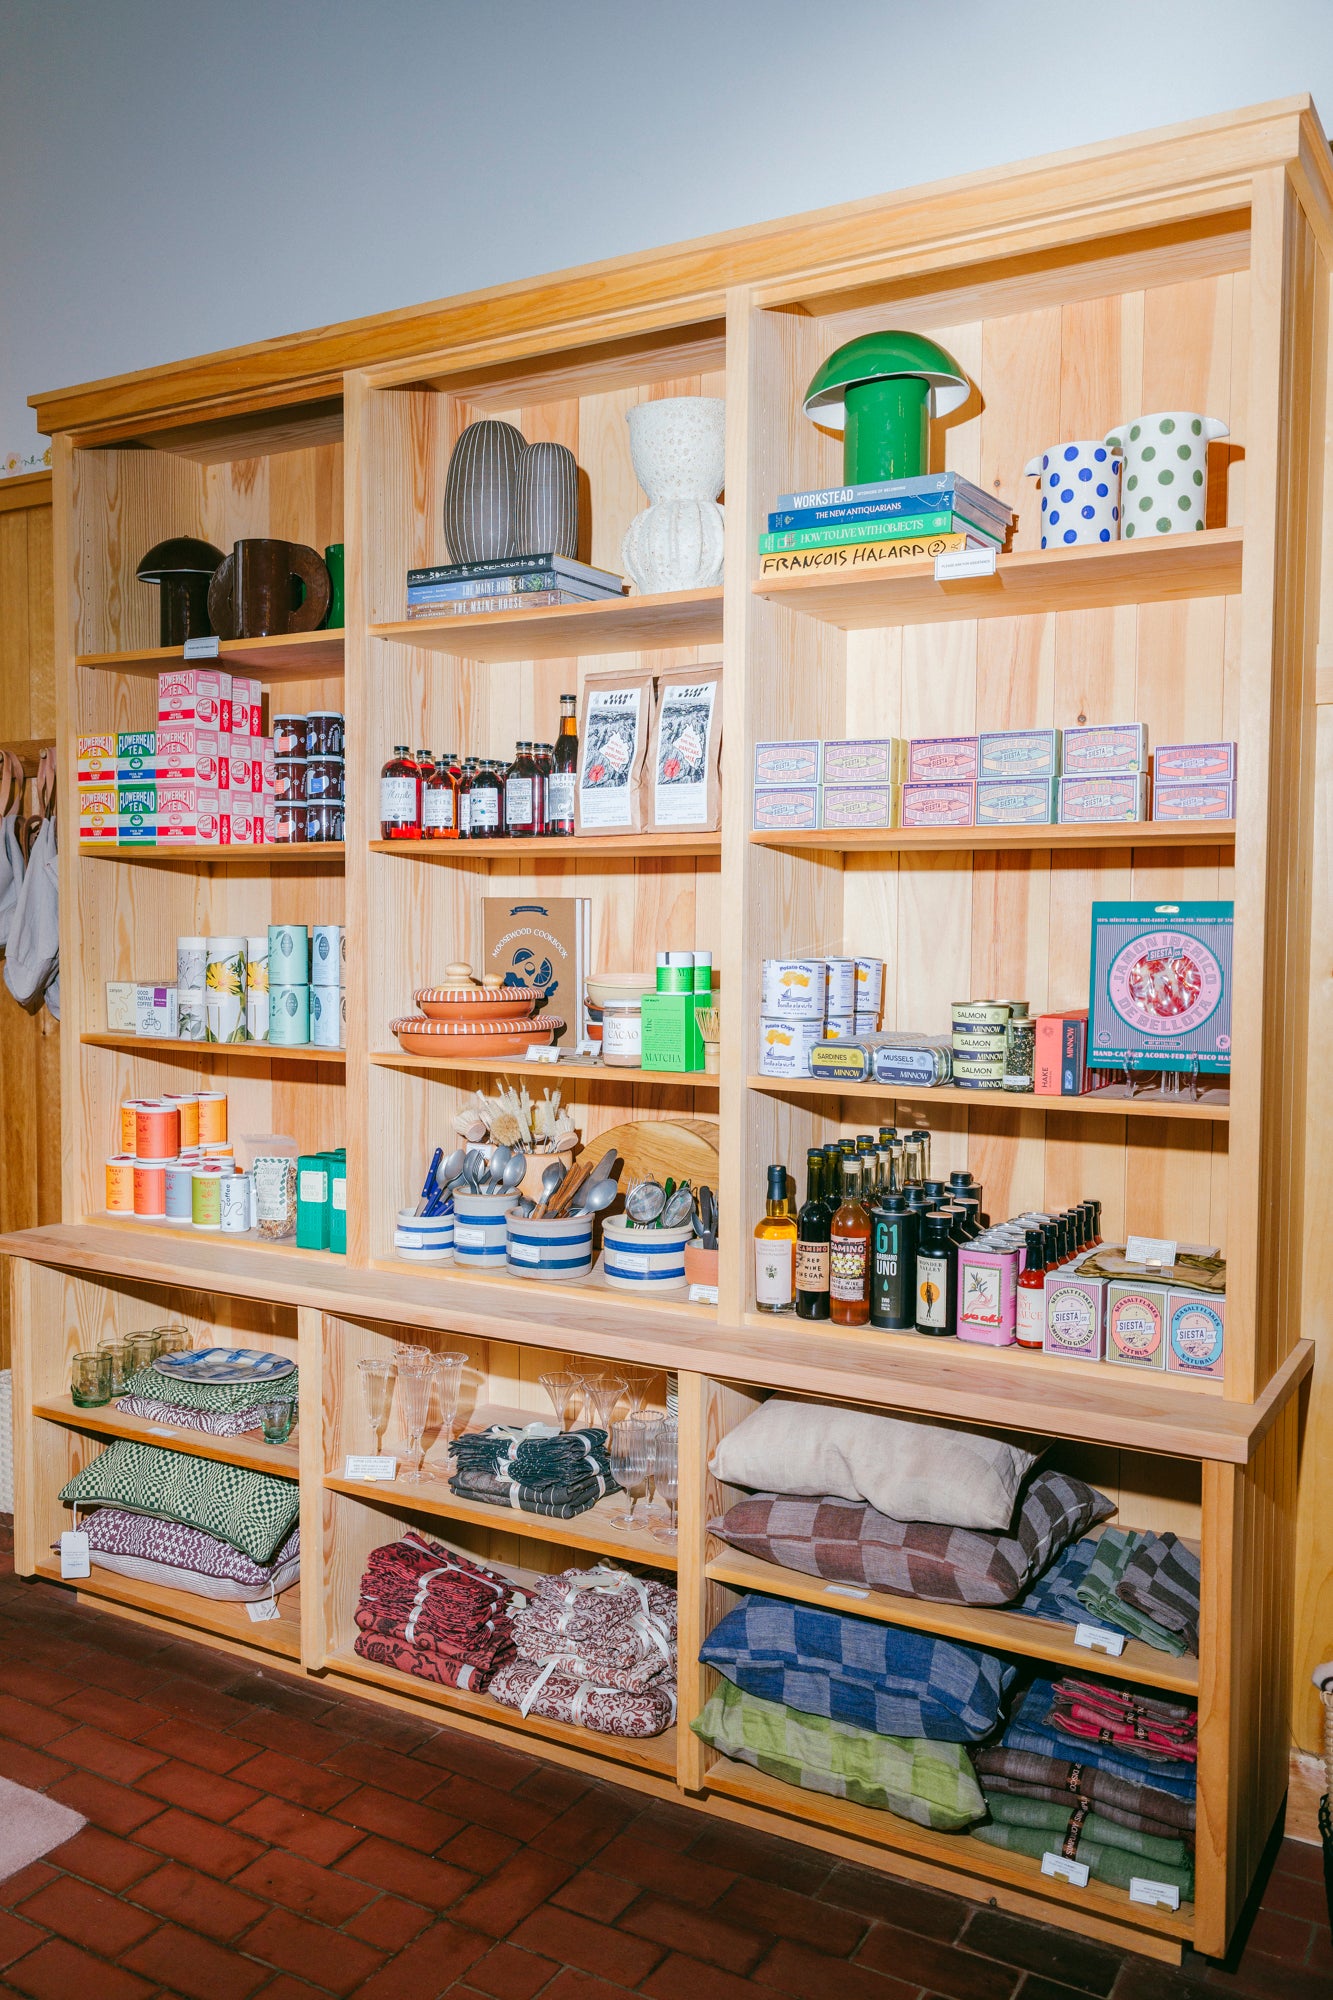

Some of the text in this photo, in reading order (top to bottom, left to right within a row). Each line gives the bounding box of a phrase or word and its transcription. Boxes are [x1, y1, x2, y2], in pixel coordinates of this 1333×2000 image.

[793, 489, 854, 509] WORKSTEAD
[815, 502, 902, 520] THE NEW ANTIQUARIANS
[800, 520, 924, 544] HOW TO LIVE WITH OBJECTS
[763, 549, 848, 574] FRANÇOIS
[852, 544, 925, 565] HALARD
[462, 583, 474, 596] THE
[475, 582, 495, 595] MAINE
[496, 579, 518, 594] HOUSE
[453, 602, 467, 614] THE
[470, 600, 494, 612] MAINE
[498, 596, 523, 609] HOUSE
[159, 672, 194, 697] FLOWERHEAD
[78, 735, 113, 758] FLOWERHEAD
[118, 732, 155, 756] FLOWERHEAD
[156, 731, 193, 755] FLOWERHEAD
[128, 746, 143, 755] TEA
[167, 744, 181, 753] TEA
[1087, 748, 1105, 758] SIESTA
[1003, 751, 1021, 760] SIESTA
[775, 762, 790, 771] SIESTA
[844, 758, 860, 767] SIESTA
[931, 758, 948, 767] SIESTA
[1183, 760, 1199, 768] SIESTA
[80, 791, 116, 814] FLOWERHEAD
[119, 790, 155, 812] FLOWERHEAD
[157, 789, 194, 812] FLOWERHEAD
[999, 798, 1016, 807] SIESTA
[1085, 798, 1103, 807] SIESTA
[89, 804, 104, 813] TEA
[128, 802, 143, 811] TEA
[168, 803, 182, 811] TEA
[924, 803, 941, 812] SIESTA
[492, 927, 568, 959] MOOSEWOOD COOKBOOK
[1149, 948, 1173, 960] SIESTA
[1114, 935, 1217, 986] JAMON IBERICO
[798, 965, 813, 973] Chips
[957, 1011, 987, 1019] SALMON
[1117, 997, 1213, 1032] DE BELLOTA
[607, 1019, 622, 1030] the
[780, 1024, 795, 1032] Chips
[827, 1020, 842, 1028] Chips
[972, 1025, 1000, 1033] MINNOW
[607, 1030, 639, 1040] CACAO
[960, 1039, 991, 1047] SALMON
[1066, 1027, 1074, 1058] MINNOW
[644, 1052, 682, 1063] MATCHA
[817, 1053, 847, 1061] SARDINES
[883, 1054, 914, 1063] MUSSELS
[1144, 1052, 1185, 1060] ACORN-FED
[833, 1068, 860, 1077] MINNOW
[900, 1070, 929, 1080] MINNOW
[961, 1066, 993, 1074] SALMON
[876, 1222, 898, 1255] G1
[798, 1245, 828, 1253] CAMINO
[831, 1241, 864, 1253] CAMINO
[876, 1253, 898, 1261] GABBIANO
[876, 1261, 897, 1276] UNO
[919, 1260, 943, 1268] WONDER
[919, 1265, 942, 1273] VALLEY
[1074, 1289, 1093, 1310] FLAKES
[1139, 1297, 1159, 1319] FLAKES
[1055, 1312, 1079, 1322] SIESTA
[1200, 1306, 1220, 1327] FLAKES
[1119, 1321, 1143, 1331] SIESTA
[1050, 1324, 1094, 1346] SMOKED GINGER
[1179, 1329, 1204, 1339] SIESTA
[1122, 1346, 1149, 1355] CITRUS
[1181, 1353, 1213, 1365] NATURAL
